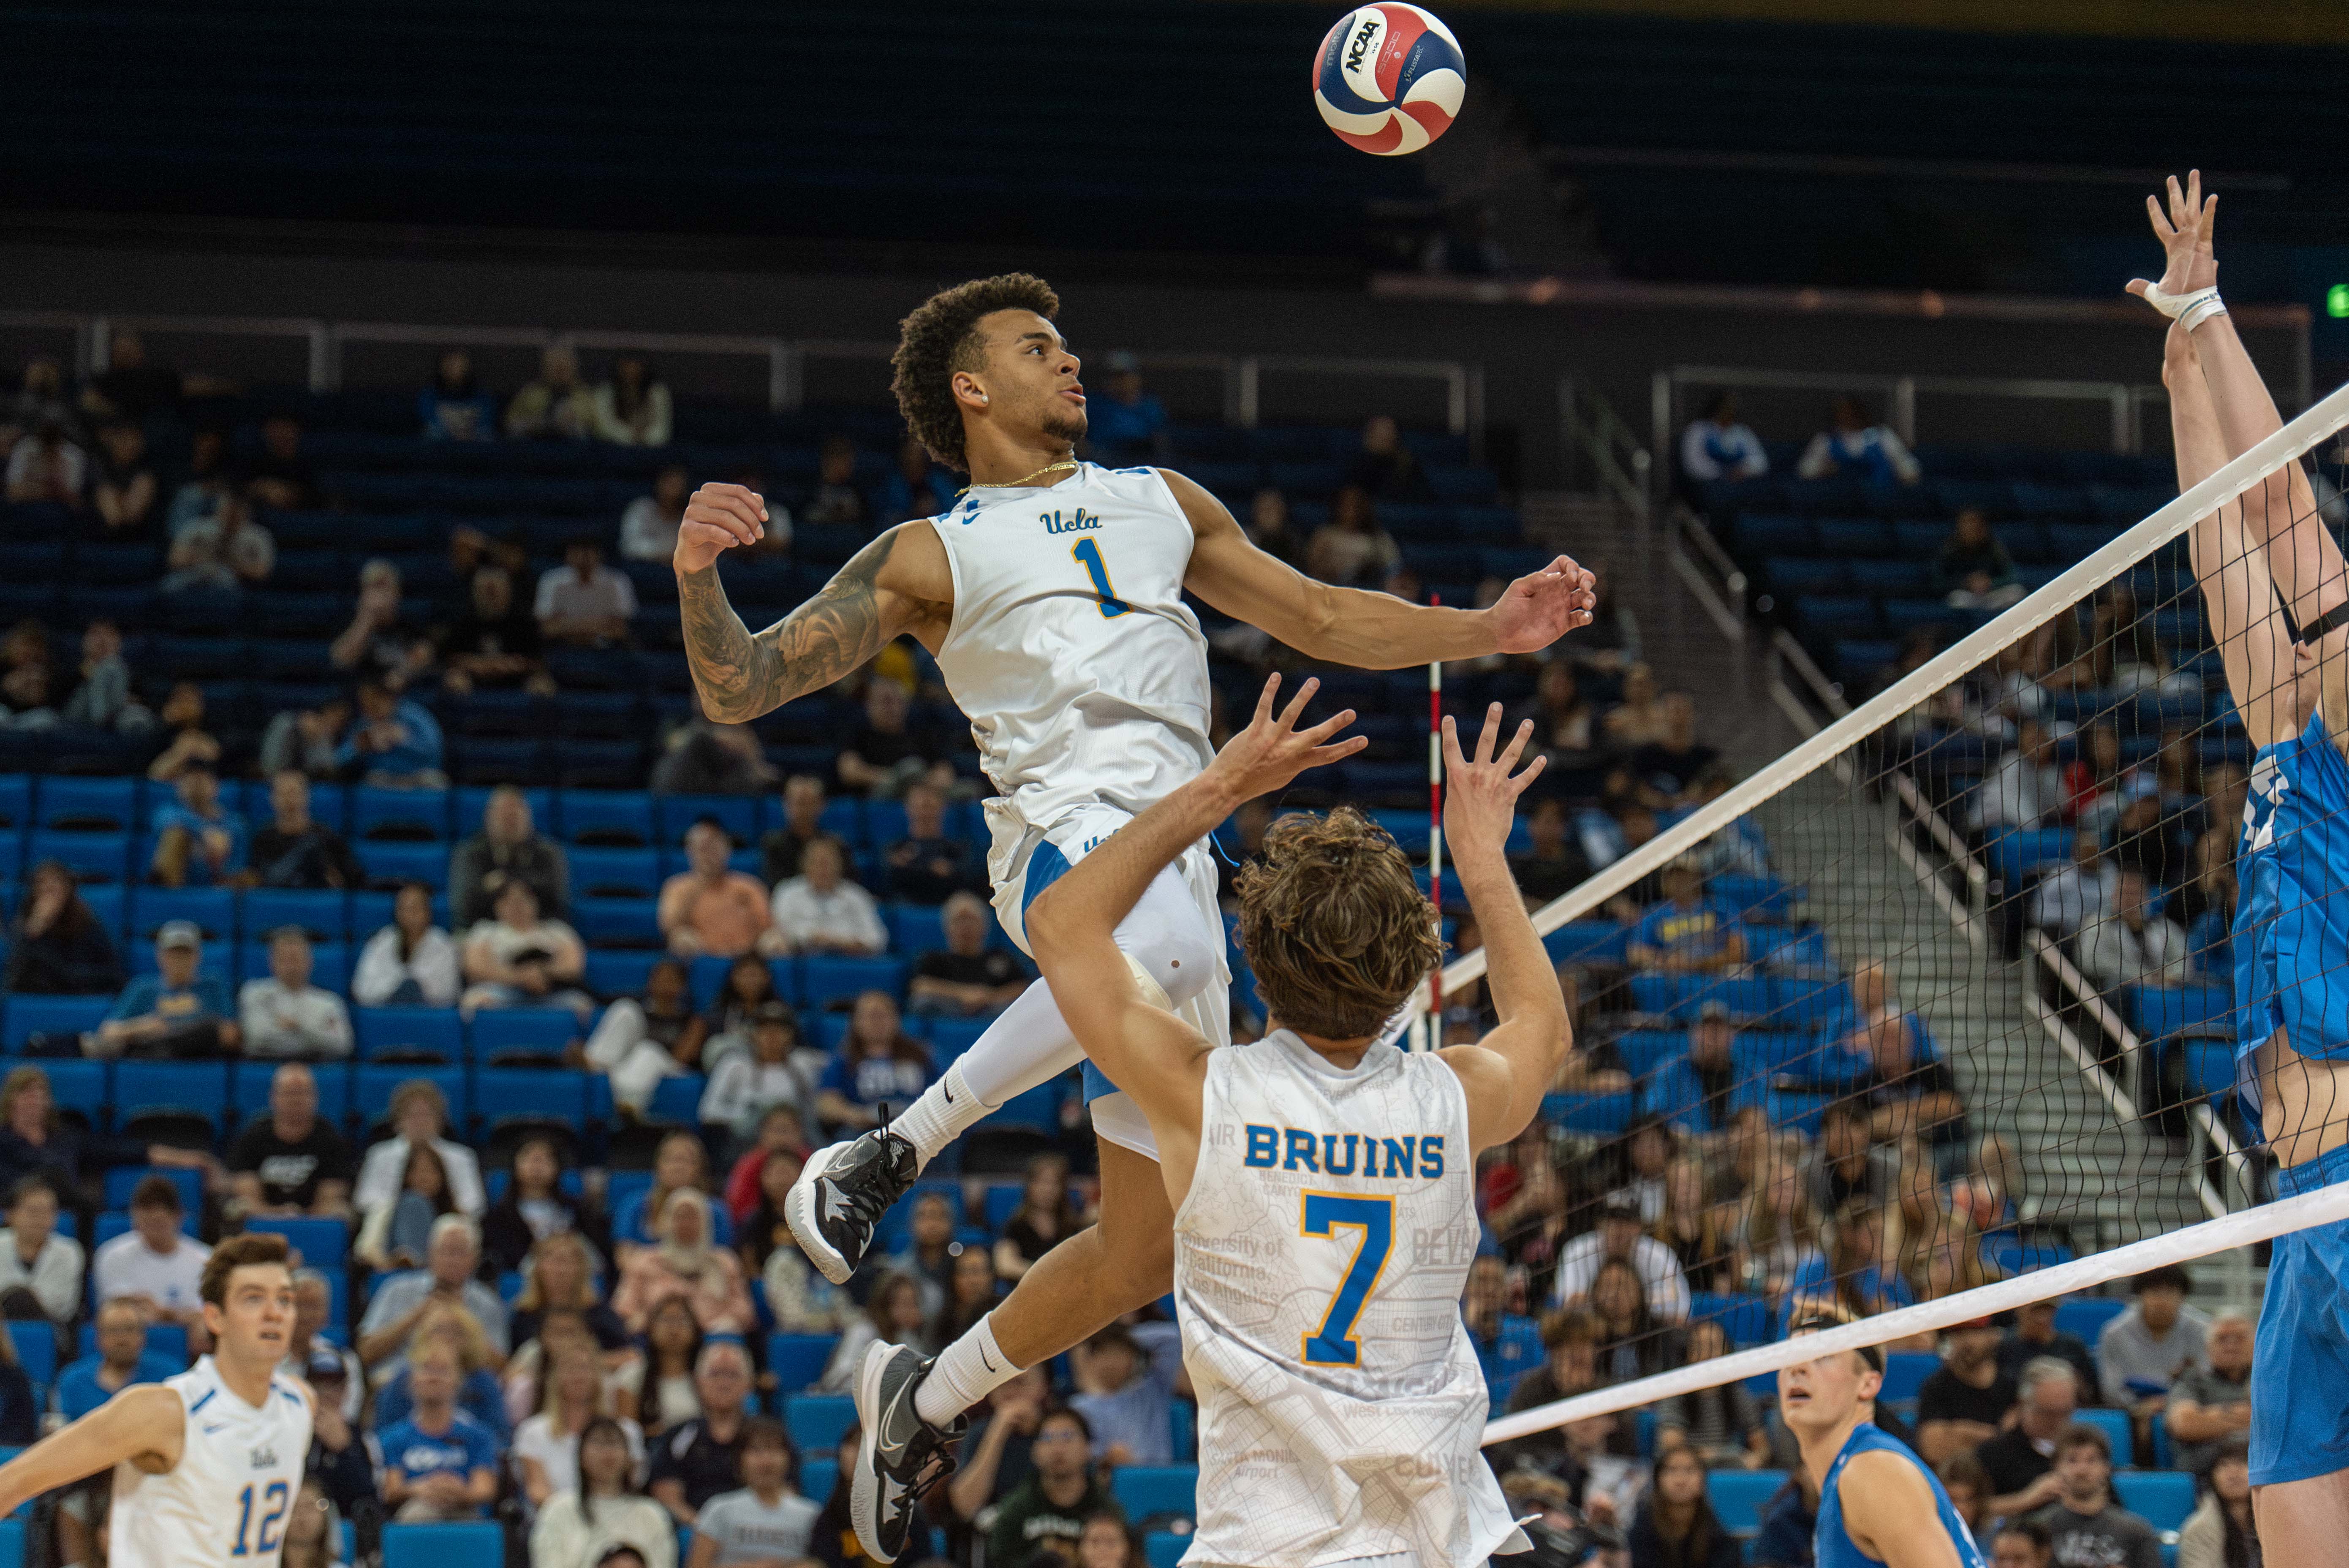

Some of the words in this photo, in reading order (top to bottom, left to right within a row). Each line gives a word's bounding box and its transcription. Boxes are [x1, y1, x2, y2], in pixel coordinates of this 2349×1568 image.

[1346, 22, 1380, 73] NCAA
[1070, 536, 1135, 620] 1
[1244, 1123, 1444, 1179] BRUINS
[1263, 1184, 1301, 1196] CANYO
[1264, 1238, 1284, 1257] of
[1300, 1189, 1396, 1369] 7
[1233, 1466, 1278, 1480] Airport
[1253, 1448, 1300, 1463] MONI
[231, 1479, 288, 1557] 12
